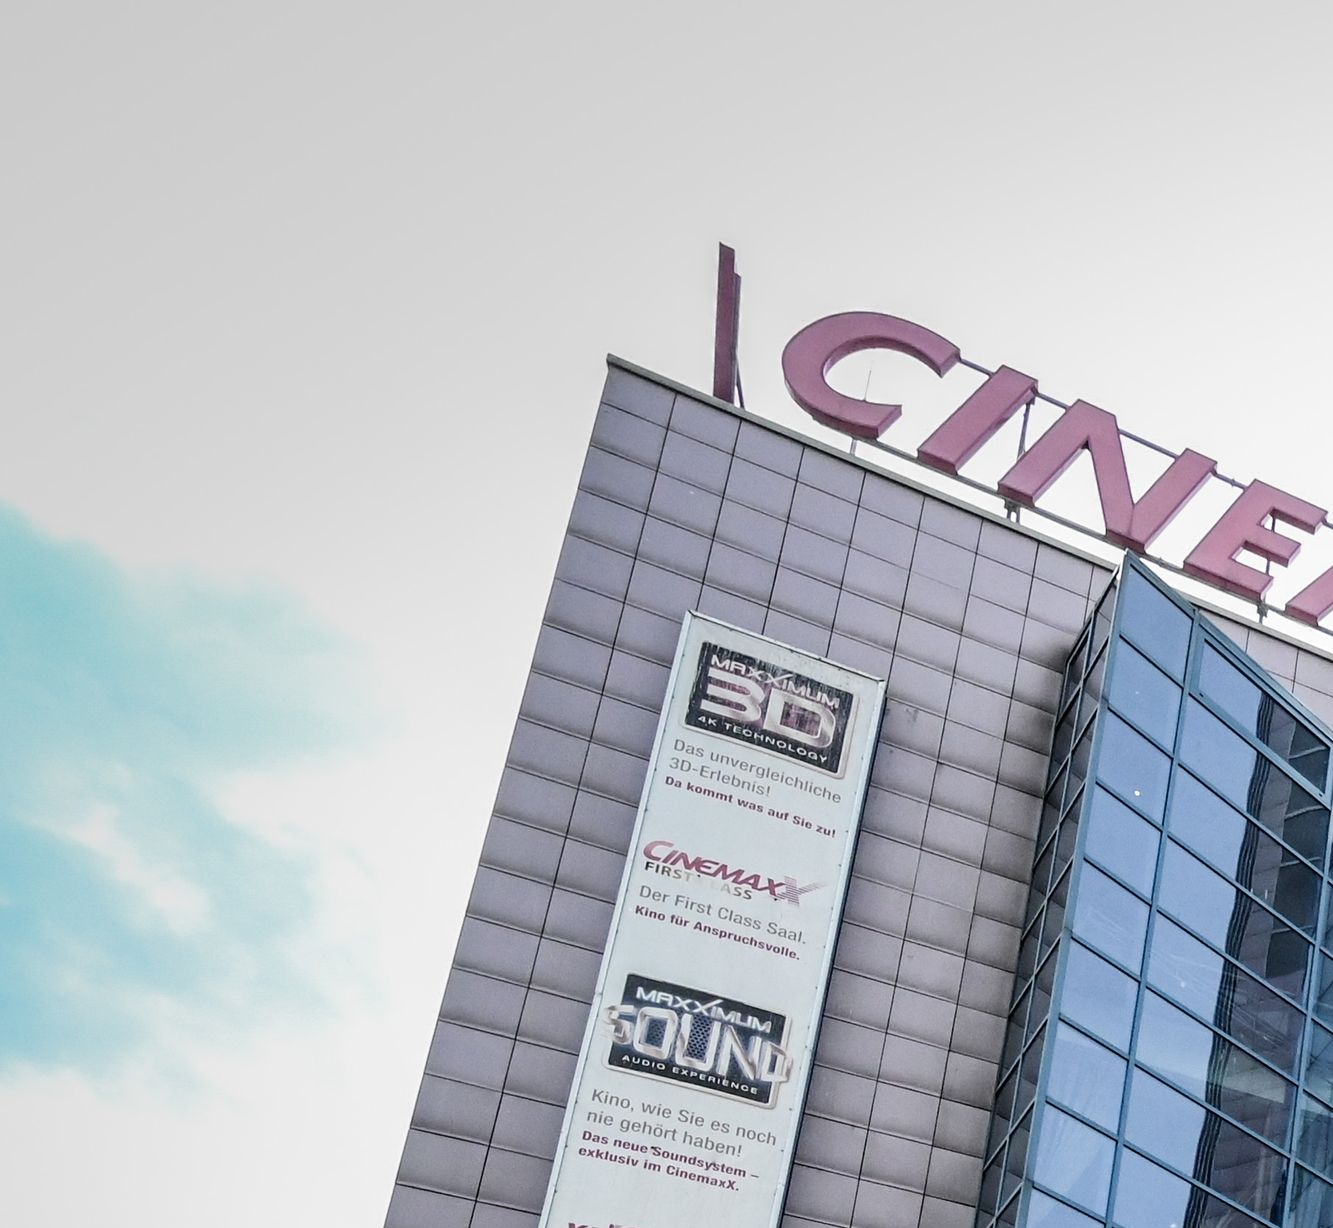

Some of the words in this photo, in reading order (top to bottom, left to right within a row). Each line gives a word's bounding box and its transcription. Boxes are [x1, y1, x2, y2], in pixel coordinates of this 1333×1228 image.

[701, 667, 836, 748] 3D
[711, 655, 840, 709] MAXXIMUM
[698, 716, 717, 727] 4K
[725, 723, 828, 764] TECHNOLOGY
[669, 757, 770, 797] 3D-Erlebnis!
[674, 739, 704, 758] Das
[710, 750, 842, 803] unvergleichliche
[665, 776, 682, 789] Da
[686, 782, 733, 804] kommt
[737, 797, 763, 813] was
[768, 807, 789, 825] auf
[793, 815, 813, 830] Sie
[816, 825, 836, 838] zu!
[645, 862, 691, 882] FIRST
[635, 905, 666, 921] Kino
[670, 914, 690, 928] für
[693, 921, 800, 960] Anspruchsvolle.
[639, 885, 670, 903] Der
[675, 895, 711, 916] First
[718, 907, 762, 930] Class
[767, 922, 807, 944] Saal.
[636, 987, 771, 1033] MAXXIMUM
[603, 1004, 793, 1083] SOUND
[621, 1054, 666, 1071] AUDIO
[672, 1067, 758, 1095] EXPERIENCE
[587, 1110, 614, 1126] nie
[620, 1116, 677, 1142] gehört
[683, 1132, 742, 1157] haben!
[592, 1089, 634, 1112] Kino,
[641, 1101, 672, 1119] wie
[678, 1109, 705, 1127] Sie
[711, 1121, 730, 1134] es
[736, 1126, 776, 1146] noch
[578, 1147, 639, 1167] exklusiv
[644, 1159, 661, 1173] im
[666, 1165, 739, 1191] CinemaxX.
[582, 1130, 608, 1145] Das
[613, 1139, 648, 1153] neue
[652, 1146, 747, 1178] Soundsystem
